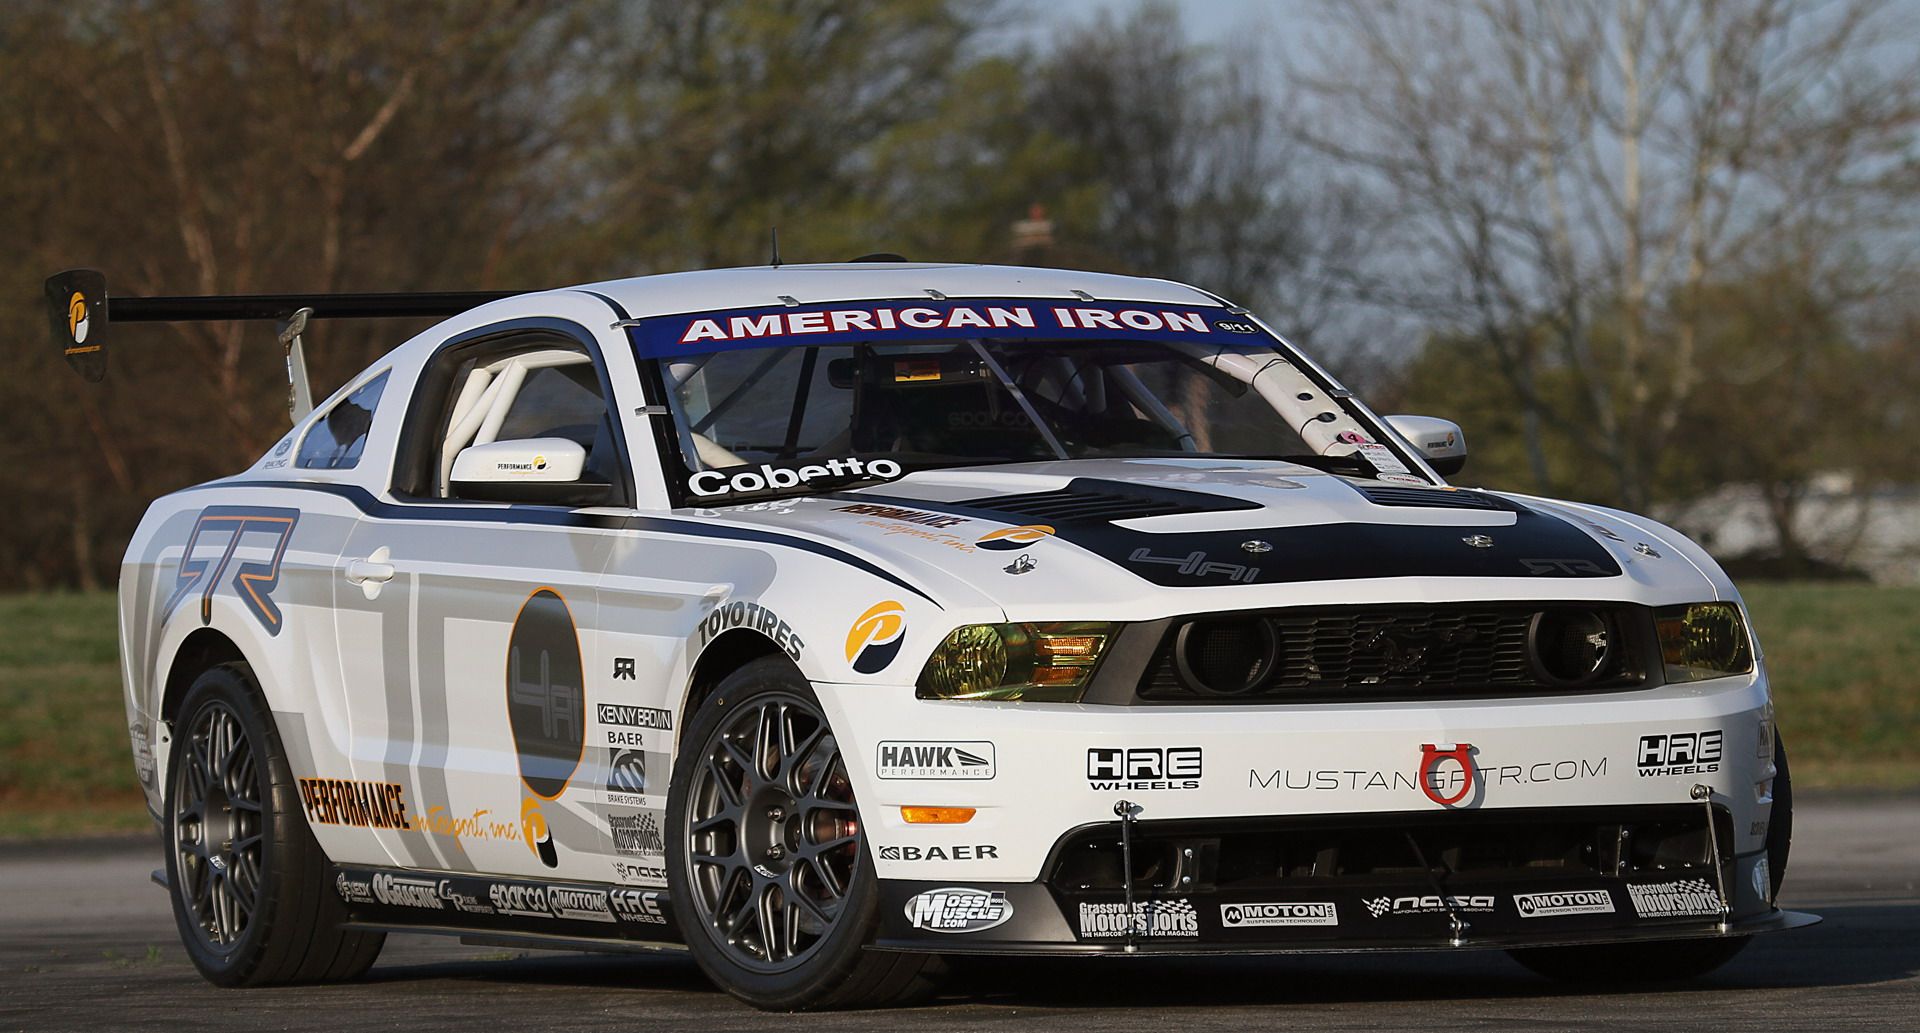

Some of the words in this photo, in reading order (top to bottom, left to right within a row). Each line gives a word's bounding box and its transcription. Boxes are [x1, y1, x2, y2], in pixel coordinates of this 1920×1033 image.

[680, 307, 1035, 343] AMERICAN
[1050, 308, 1210, 333] IRON
[1218, 322, 1257, 332] 9/11
[688, 457, 902, 496] Cobetto
[698, 602, 745, 647] TOYO
[747, 602, 804, 662] TIRES
[599, 705, 636, 725] KENNY
[637, 708, 671, 729] BROWN
[607, 731, 643, 745] BAER
[882, 746, 953, 767] HAWK
[1637, 730, 1722, 767] HRE
[1087, 747, 1202, 780] HRE
[1639, 764, 1719, 777] WHEELS
[1090, 781, 1199, 790] WHEELS
[299, 780, 410, 830] PERFORMANCE
[608, 794, 624, 804] BRAKE
[624, 796, 646, 806] SYSTEMS
[611, 828, 662, 852] Motorsports
[903, 844, 999, 860] BAER
[490, 884, 548, 915] sparco
[1626, 883, 1679, 896] Grassroots
[560, 891, 603, 911] MOTON
[610, 889, 661, 915] HRE
[1079, 902, 1148, 913] Grassrots
[1393, 896, 1495, 909] nasa
[1534, 893, 1603, 907] MOTON
[1631, 892, 1721, 916] Motorsports
[621, 912, 667, 924] WHEELS
[1244, 906, 1325, 917] MOTON
